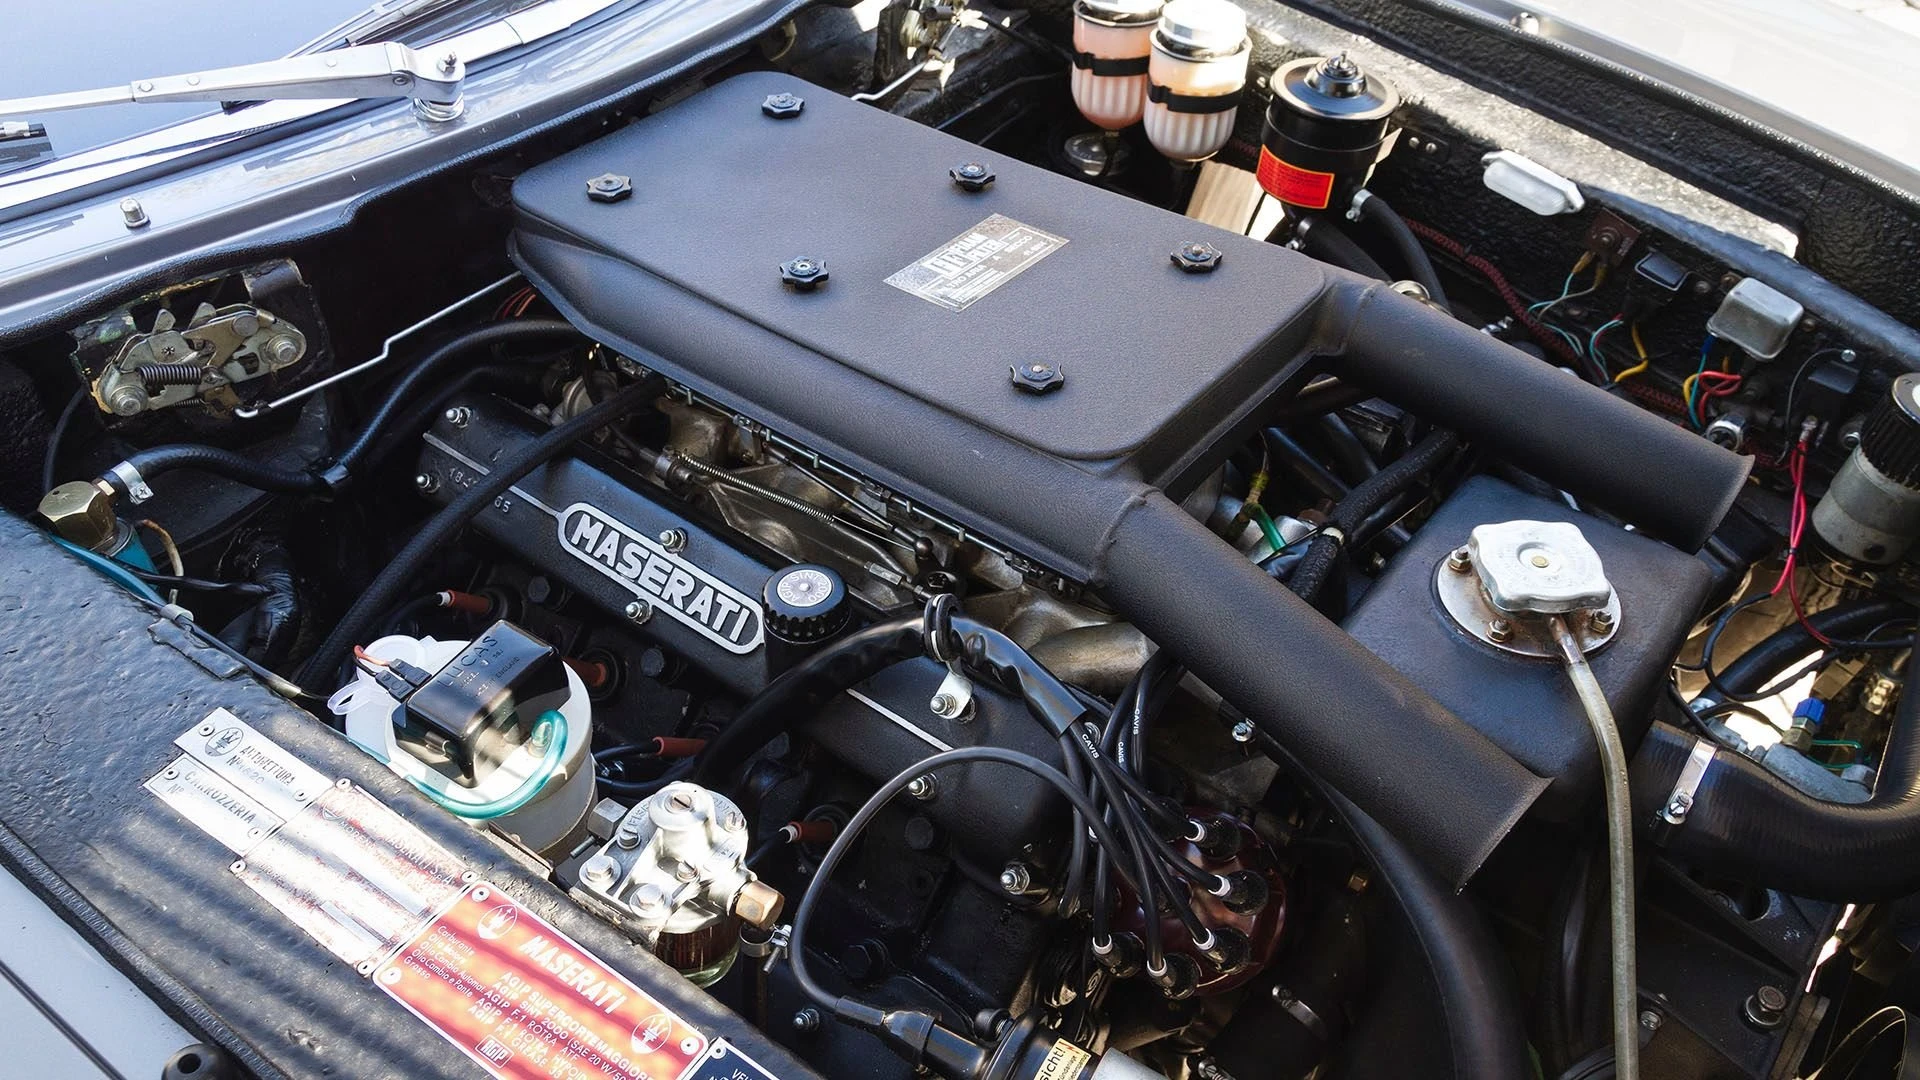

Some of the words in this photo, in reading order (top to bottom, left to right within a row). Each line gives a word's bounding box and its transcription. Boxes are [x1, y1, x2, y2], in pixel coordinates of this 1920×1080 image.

[571, 513, 750, 642] MASERATI
[781, 581, 801, 602] AGIP
[807, 581, 828, 603] 2000
[437, 635, 498, 688] LUCAS
[1081, 733, 1100, 760] CAVIS
[1132, 708, 1141, 736] CAVIS
[184, 770, 257, 824] CARROZZERIA
[428, 933, 443, 949] Olio
[492, 982, 520, 1000] AGIP
[541, 1017, 569, 1040] 2000
[568, 1037, 590, 1057] (SAE
[588, 1054, 601, 1066] 20
[519, 935, 629, 1015] MASERATI
[403, 956, 431, 980] Grasso
[468, 1005, 496, 1025] AGIP
[511, 1037, 548, 1067] GREASE
[437, 925, 476, 956] Carburante
[500, 972, 532, 993] AGIP
[528, 991, 655, 1080] SUPERCORTEMAGGIOR
[475, 998, 502, 1017] AGIP
[484, 990, 511, 1008] AGIP
[511, 1008, 527, 1023] F.1
[527, 1020, 558, 1046] ROTRA
[560, 1046, 580, 1060] ATF
[480, 1039, 509, 1062] AGIP
